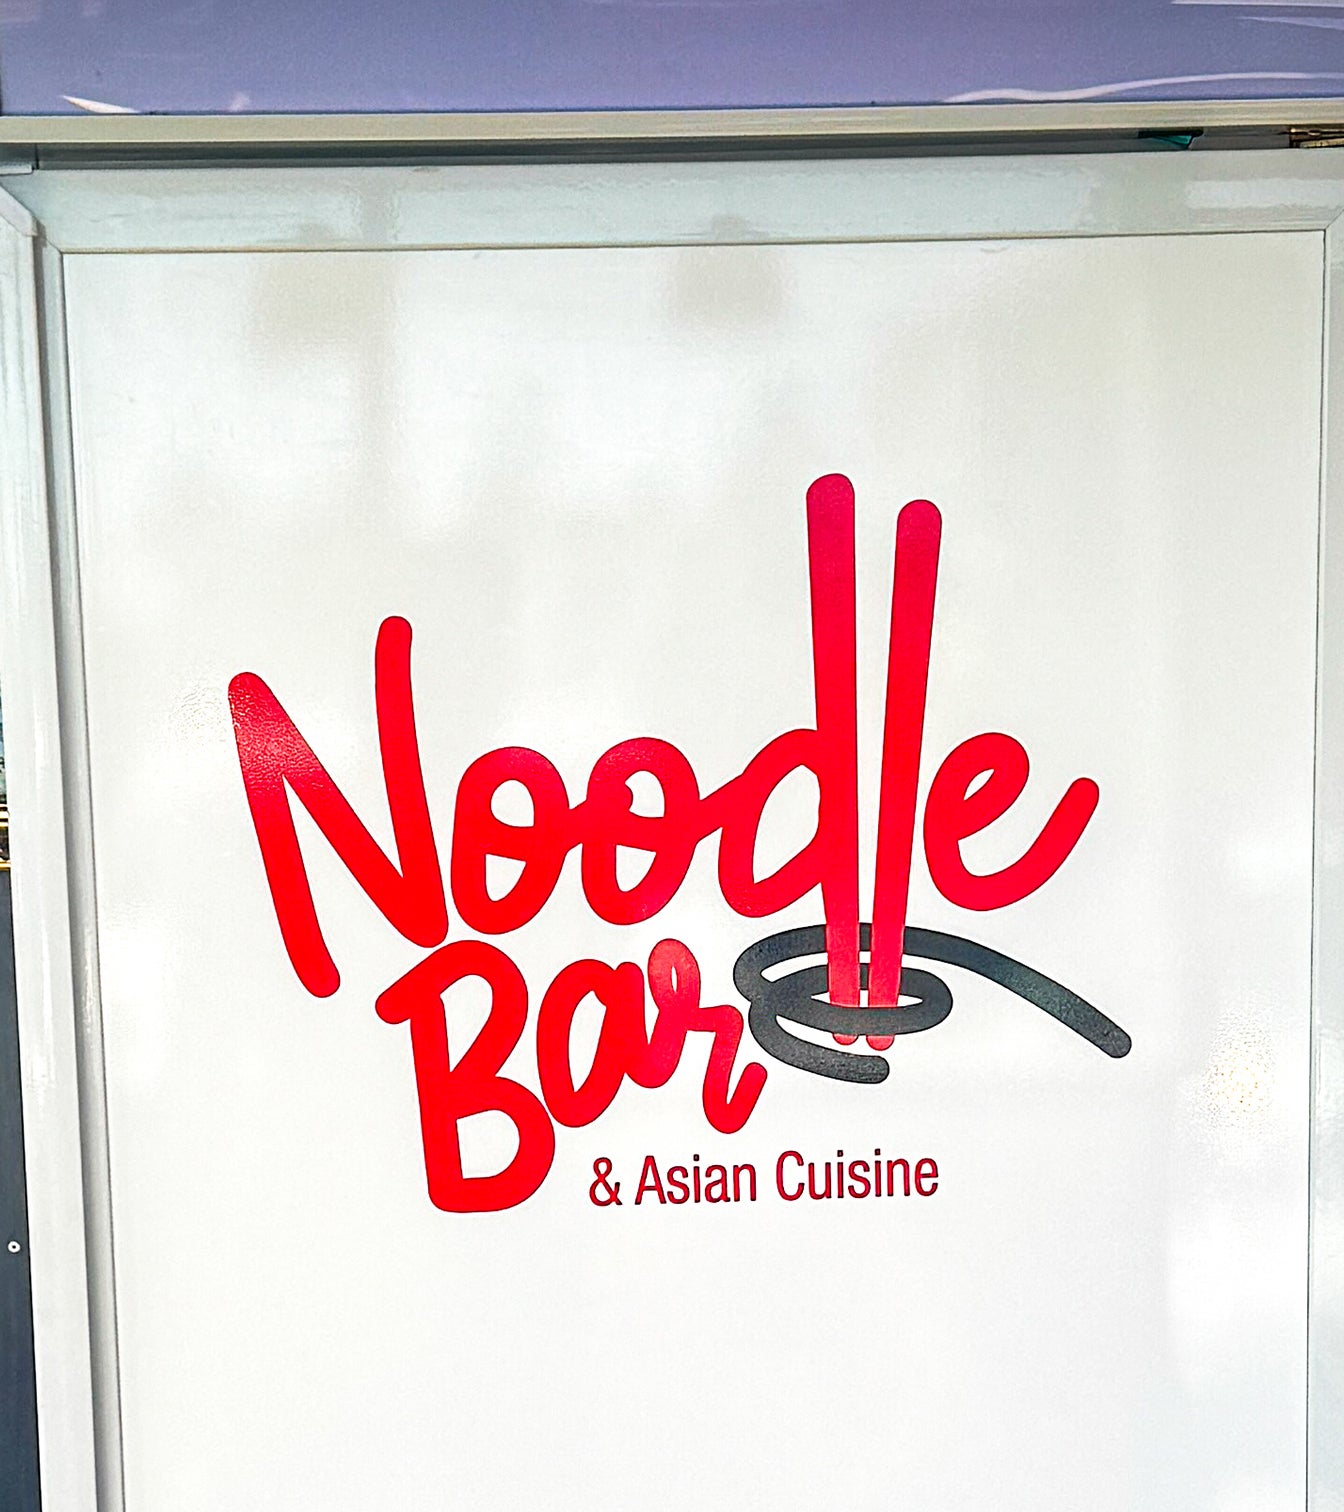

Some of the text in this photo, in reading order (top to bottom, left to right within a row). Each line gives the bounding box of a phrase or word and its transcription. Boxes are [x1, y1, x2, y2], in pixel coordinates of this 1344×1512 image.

[228, 473, 1100, 1050] Noodle
[375, 938, 767, 1213] Bar
[588, 1147, 940, 1207] & Asian Cuisine
